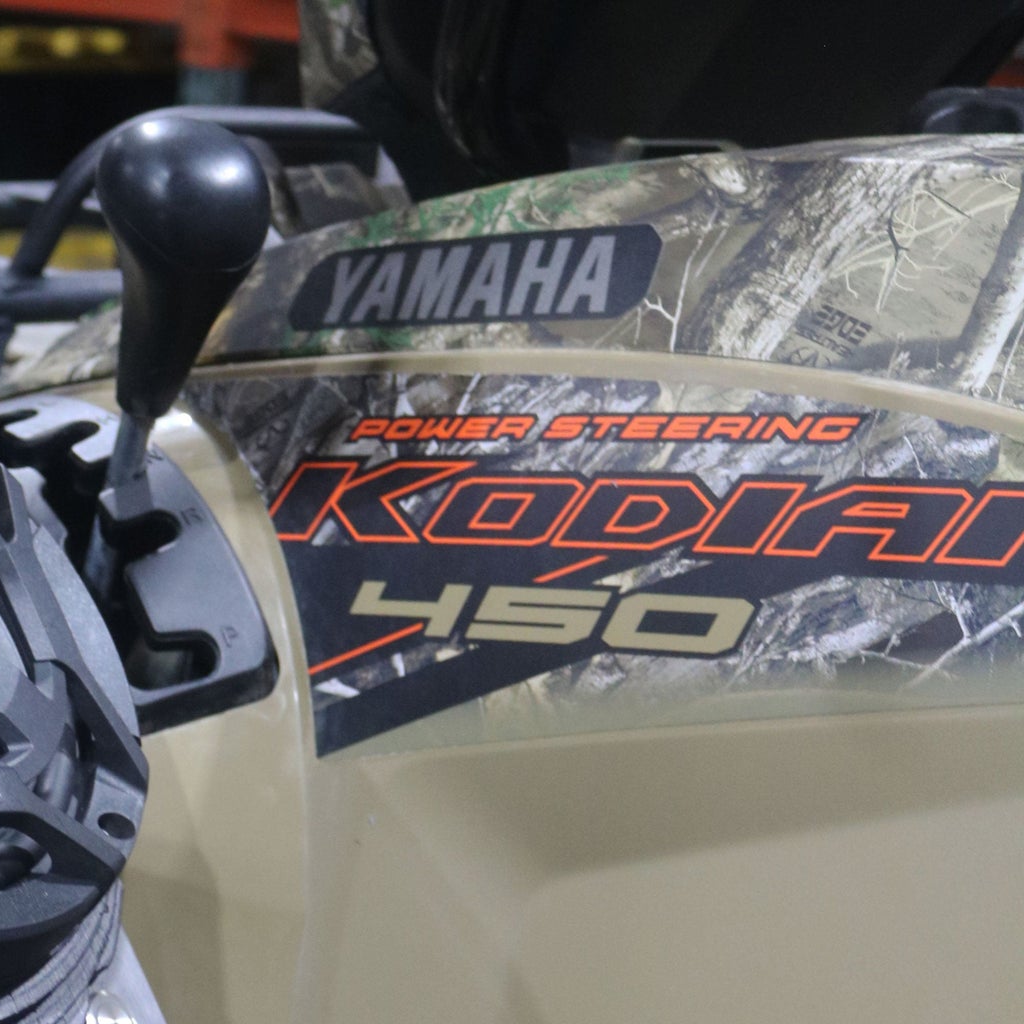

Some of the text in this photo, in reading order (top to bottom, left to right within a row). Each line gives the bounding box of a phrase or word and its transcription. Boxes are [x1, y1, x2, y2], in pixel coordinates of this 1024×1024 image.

[319, 235, 617, 324] YAMAHA
[350, 415, 862, 442] POWER STEERING
[350, 580, 757, 655] 450
